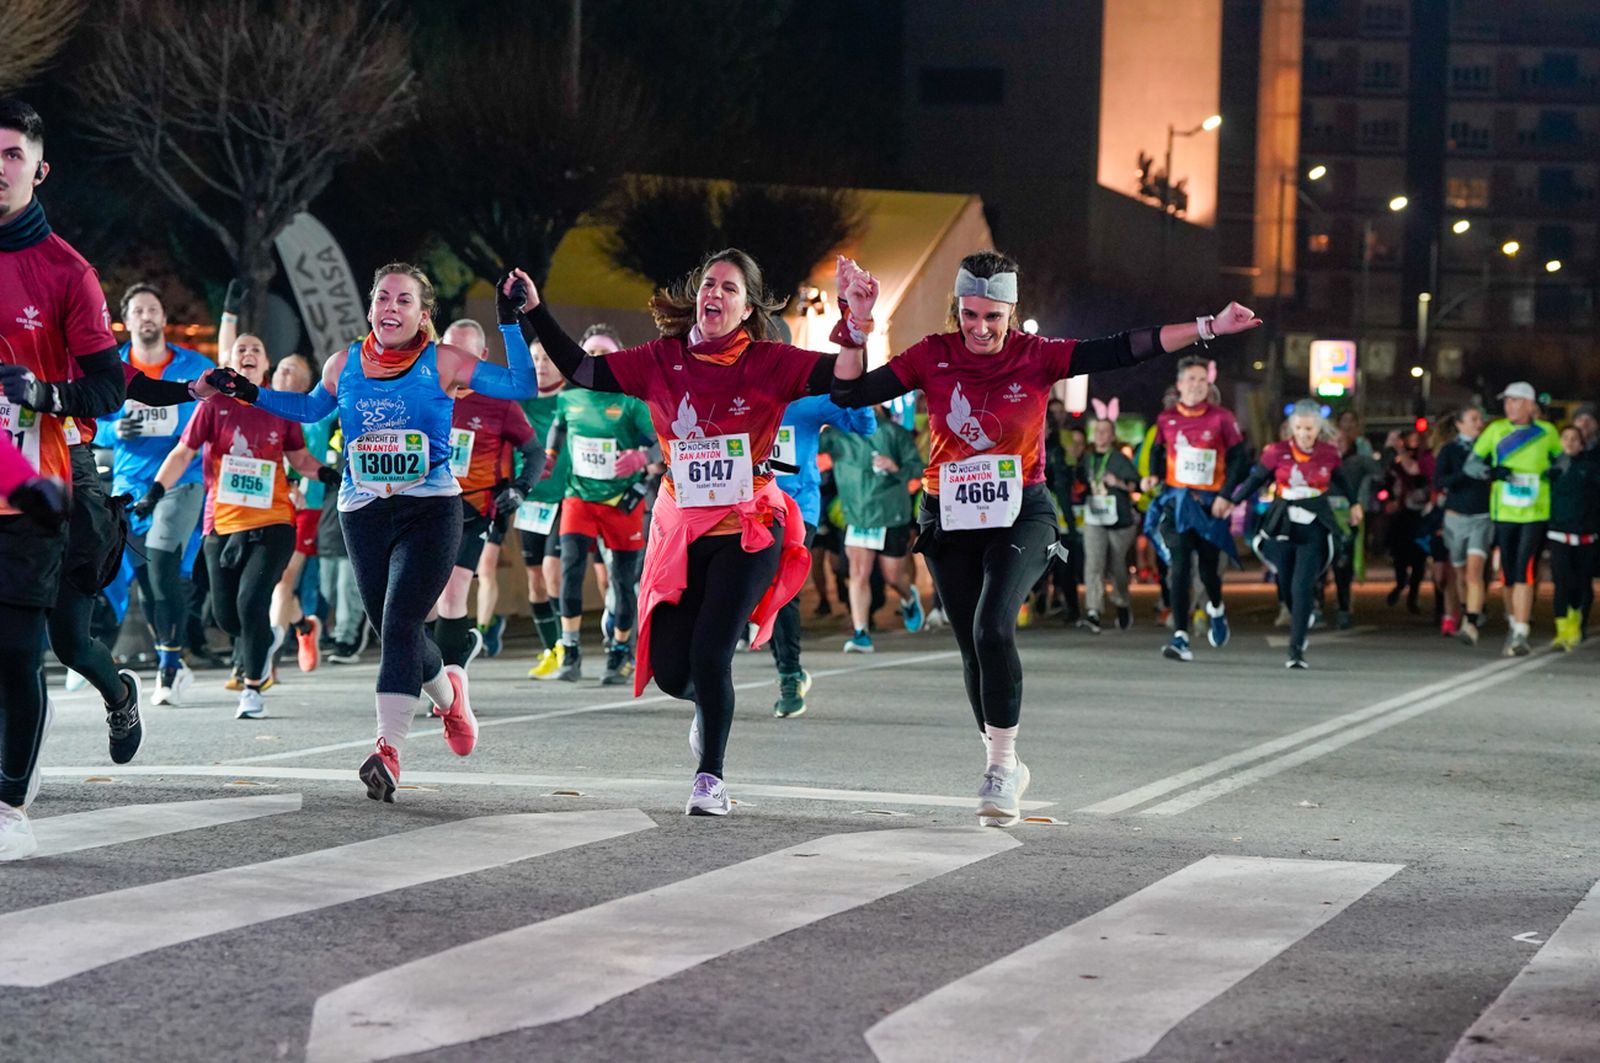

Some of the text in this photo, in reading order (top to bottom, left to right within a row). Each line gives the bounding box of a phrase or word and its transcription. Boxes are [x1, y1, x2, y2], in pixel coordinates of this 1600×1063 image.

[960, 422, 981, 442] 43
[365, 435, 388, 443] NOCHE
[688, 443, 710, 451] NOCHE
[679, 453, 694, 461] SAN
[359, 453, 419, 475] 13002
[959, 465, 981, 473] NOCHE
[689, 459, 734, 482] 6147
[231, 474, 263, 491] 8156
[949, 475, 965, 483] SAN
[955, 481, 1010, 504] 4664
